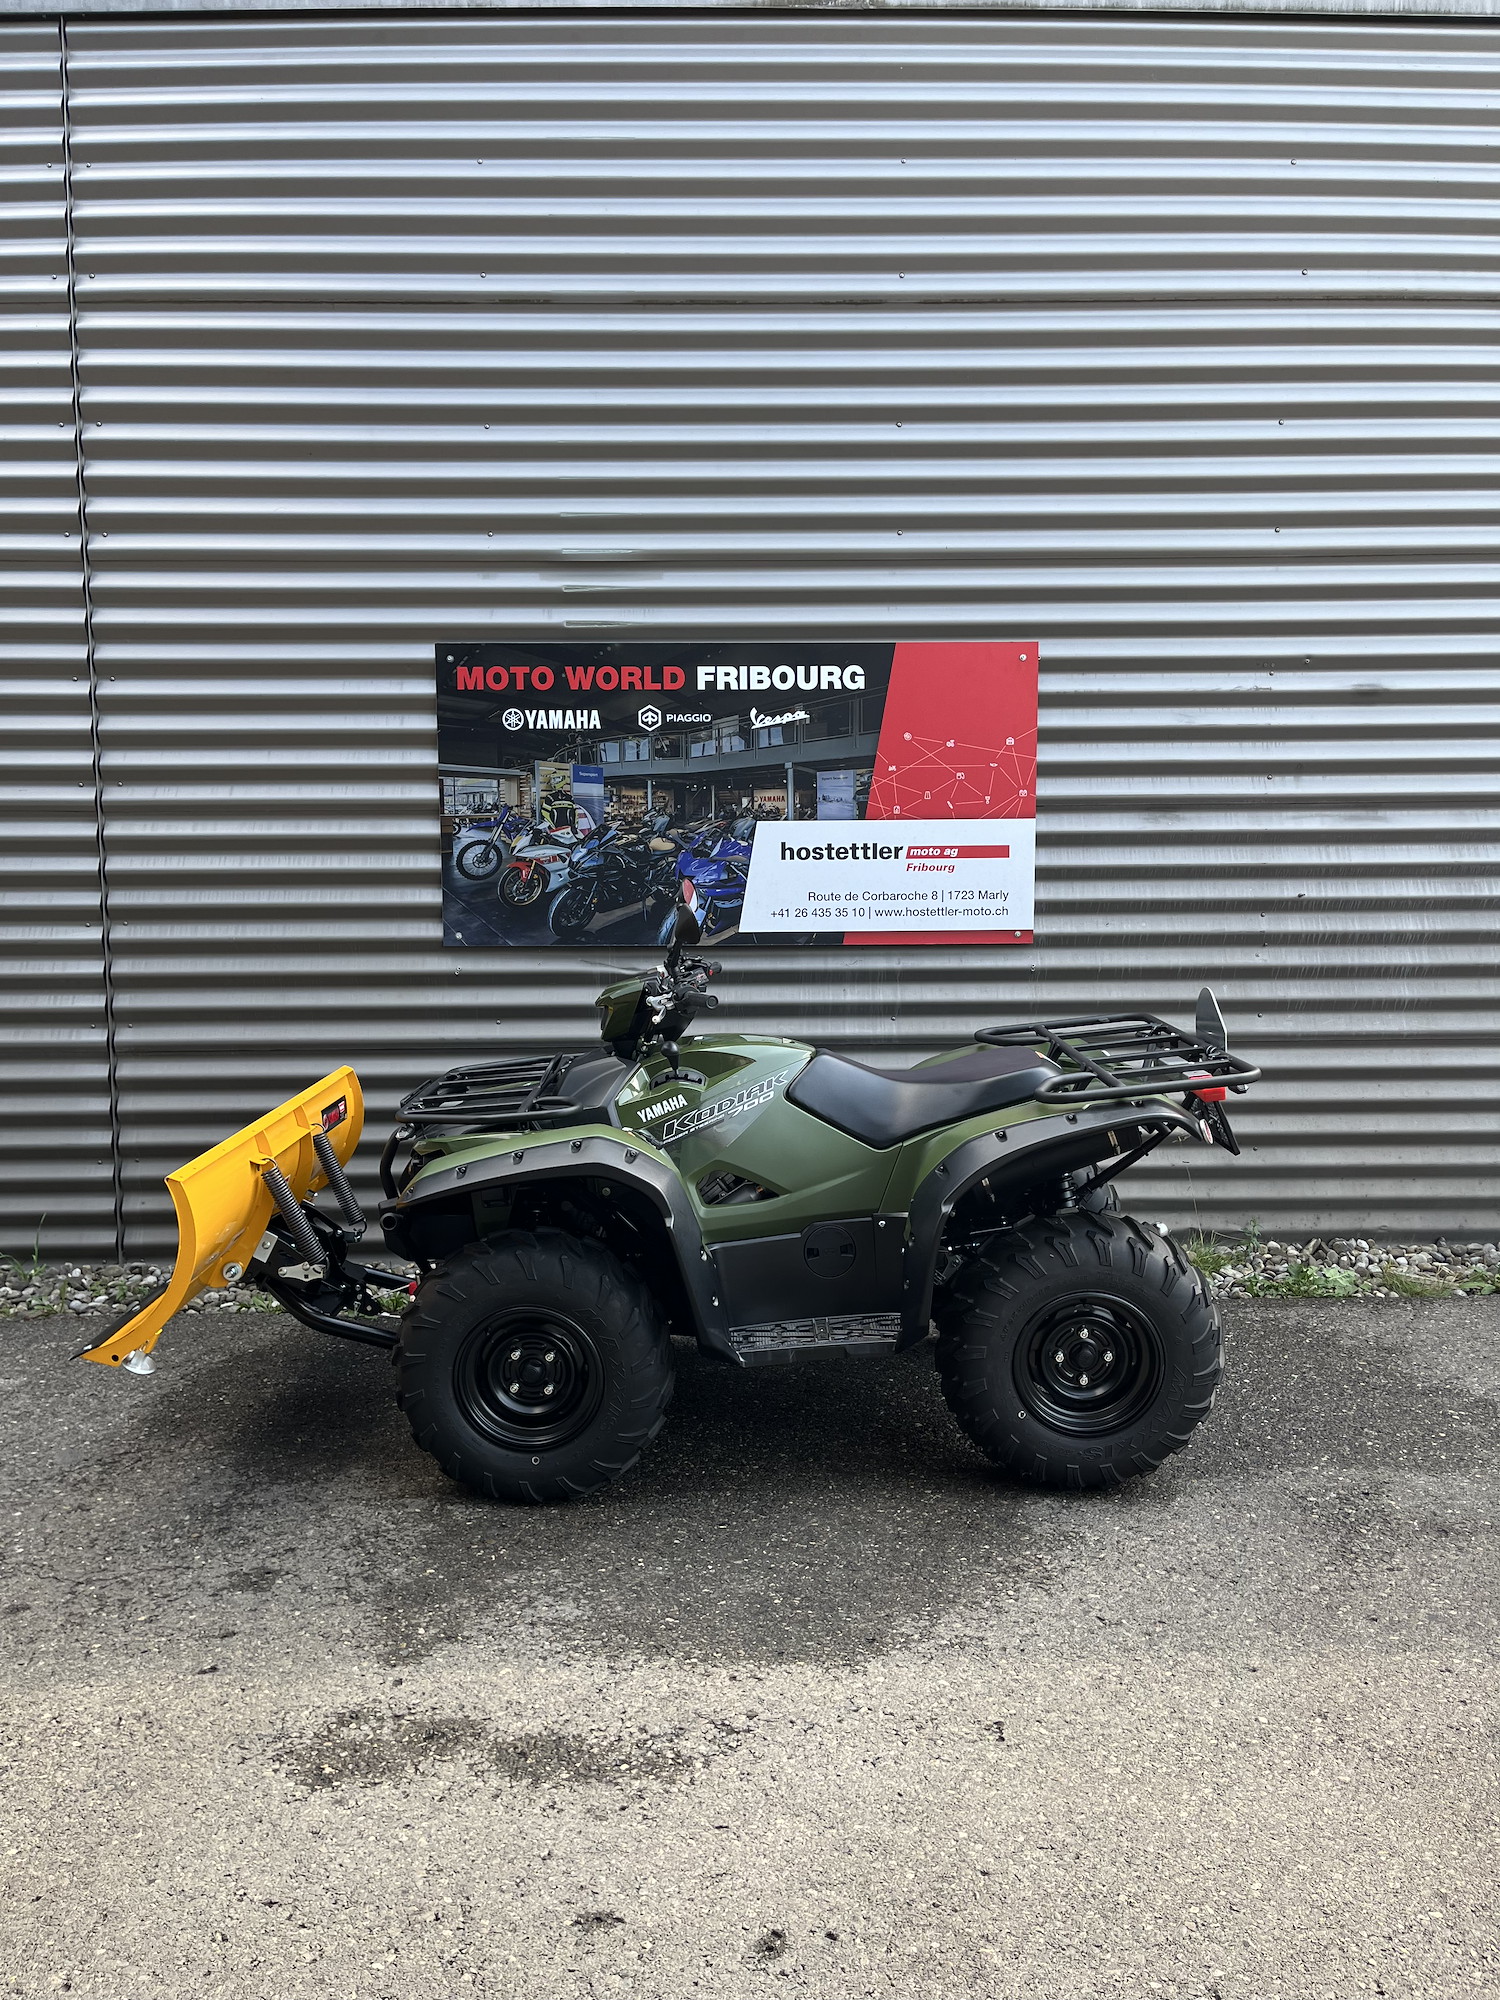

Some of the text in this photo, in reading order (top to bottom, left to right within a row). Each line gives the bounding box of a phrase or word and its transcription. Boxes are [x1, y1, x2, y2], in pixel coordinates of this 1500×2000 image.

[456, 664, 866, 691] MOTO WORLD FRIBOURG
[525, 709, 602, 730] YAMAHA
[666, 713, 712, 723] PIAGGIO
[750, 707, 811, 729] Vespa
[760, 795, 786, 803] YAMAHA
[780, 841, 959, 861] hostettler moto ag
[906, 862, 955, 873] Fribourg
[808, 891, 841, 901] Route
[844, 891, 859, 901] de
[862, 890, 928, 901] Corbaroche
[931, 890, 938, 900] 8
[948, 890, 975, 900] 1723
[978, 890, 1009, 902] Marly
[770, 908, 790, 918] +41
[794, 908, 808, 918] 26
[811, 908, 832, 918] 435
[835, 908, 849, 918] 35
[852, 907, 865, 917] 10
[874, 906, 1009, 917] www.hostettler-moto.ch
[637, 1094, 689, 1123] YAMAHA
[662, 1069, 789, 1140] KODIAK
[727, 1090, 775, 1118] 700
[1080, 1364, 1188, 1460] MAXXIS
